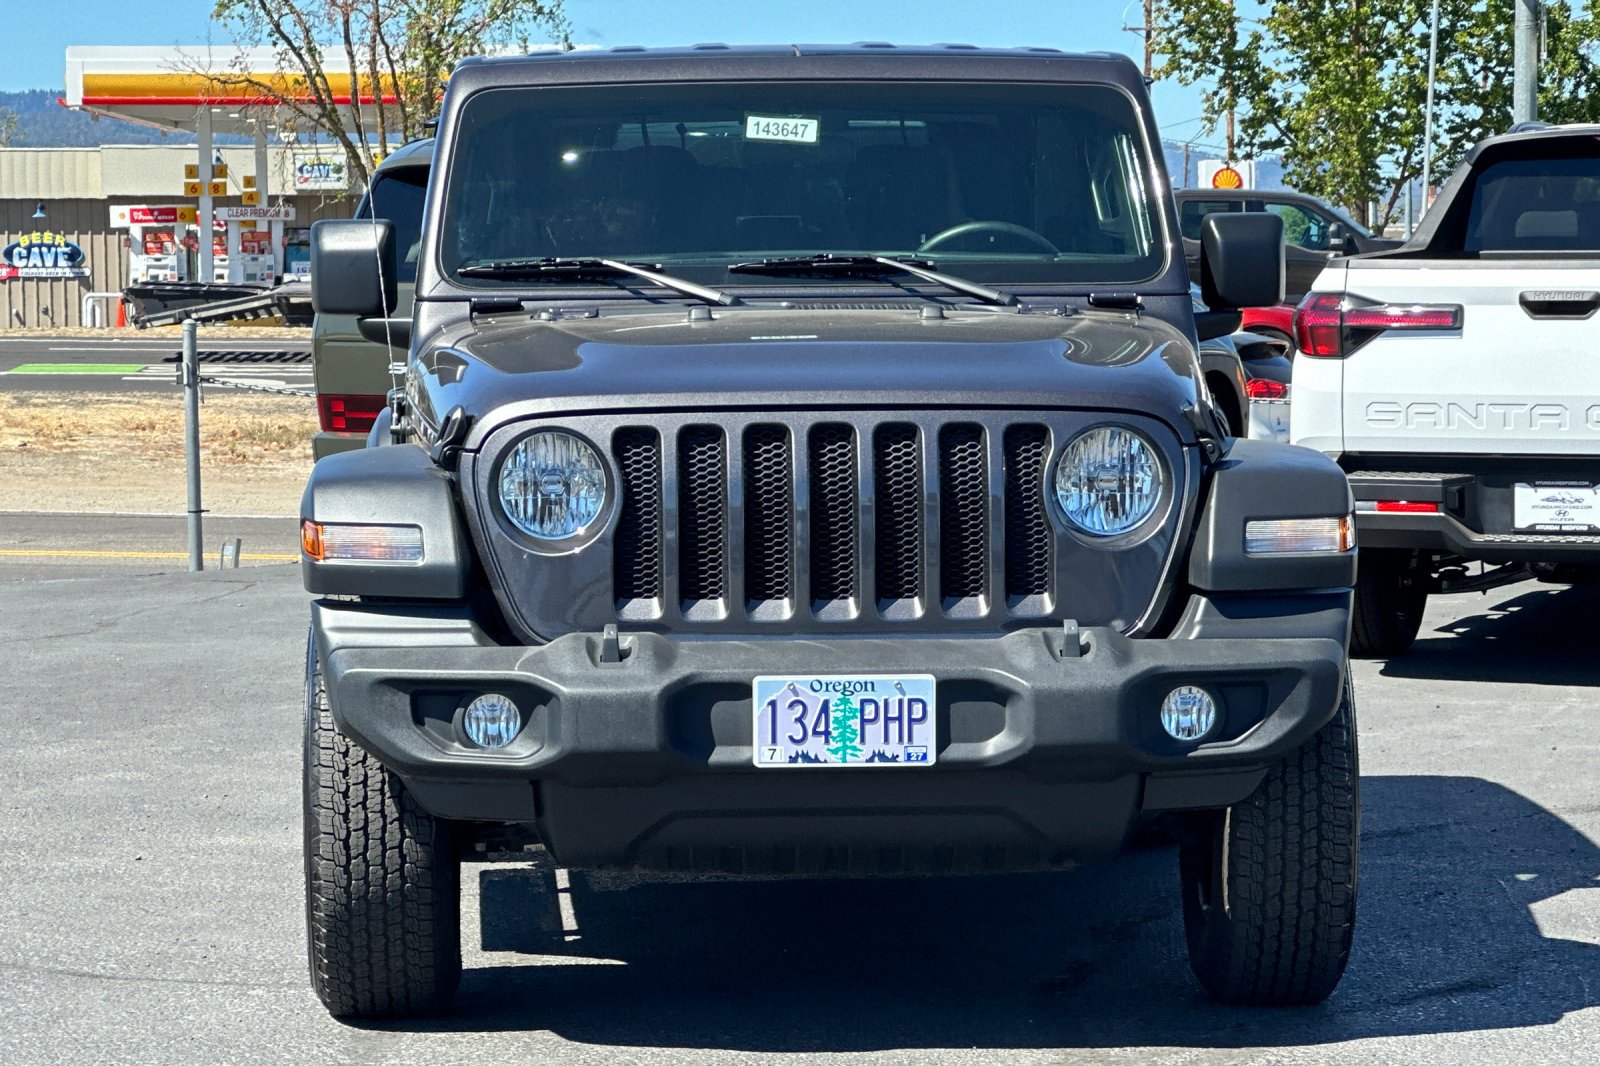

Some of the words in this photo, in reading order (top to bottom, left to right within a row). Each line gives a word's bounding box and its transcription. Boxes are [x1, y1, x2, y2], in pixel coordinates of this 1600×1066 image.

[753, 121, 809, 138] 143647
[190, 184, 198, 194] 6
[212, 184, 220, 194] 8
[246, 193, 254, 202] 4
[180, 212, 186, 220] 6
[227, 208, 249, 218] CLEAR
[283, 209, 290, 218] 8
[19, 232, 65, 247] BEER
[12, 246, 72, 267] CAVE
[1533, 291, 1585, 300] HYUNDAI
[1365, 401, 1570, 431] SANTA
[809, 679, 878, 697] Oregon
[767, 698, 832, 745] 134
[859, 697, 928, 745] PHP
[767, 748, 777, 761] 7
[910, 752, 924, 761] 27
